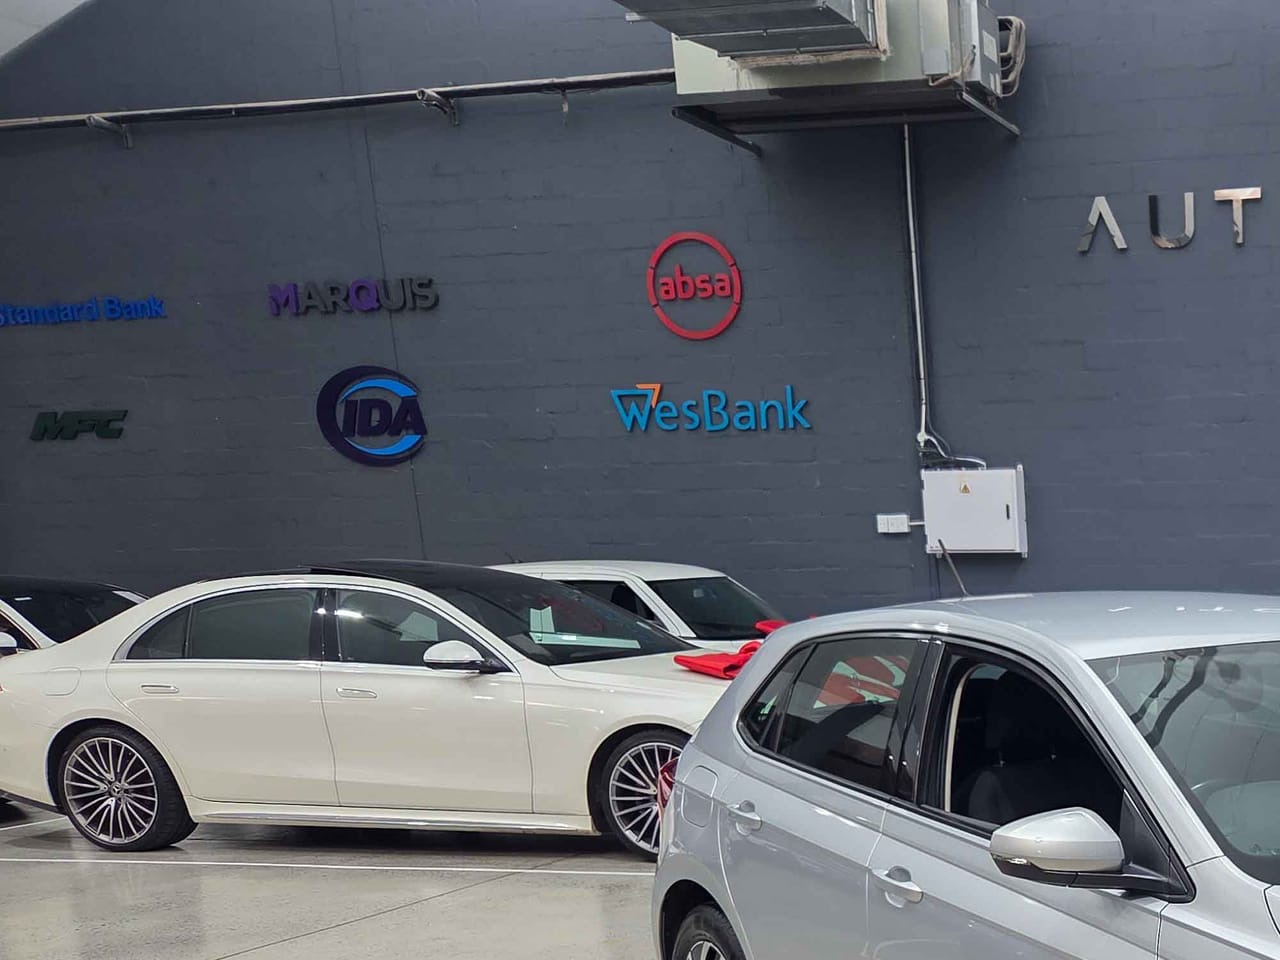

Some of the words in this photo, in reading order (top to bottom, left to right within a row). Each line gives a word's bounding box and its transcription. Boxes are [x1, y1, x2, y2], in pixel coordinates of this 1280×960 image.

[268, 278, 440, 316] MARQUIS
[659, 264, 732, 300] absa
[104, 295, 167, 320] Bank
[610, 384, 812, 432] WesBank
